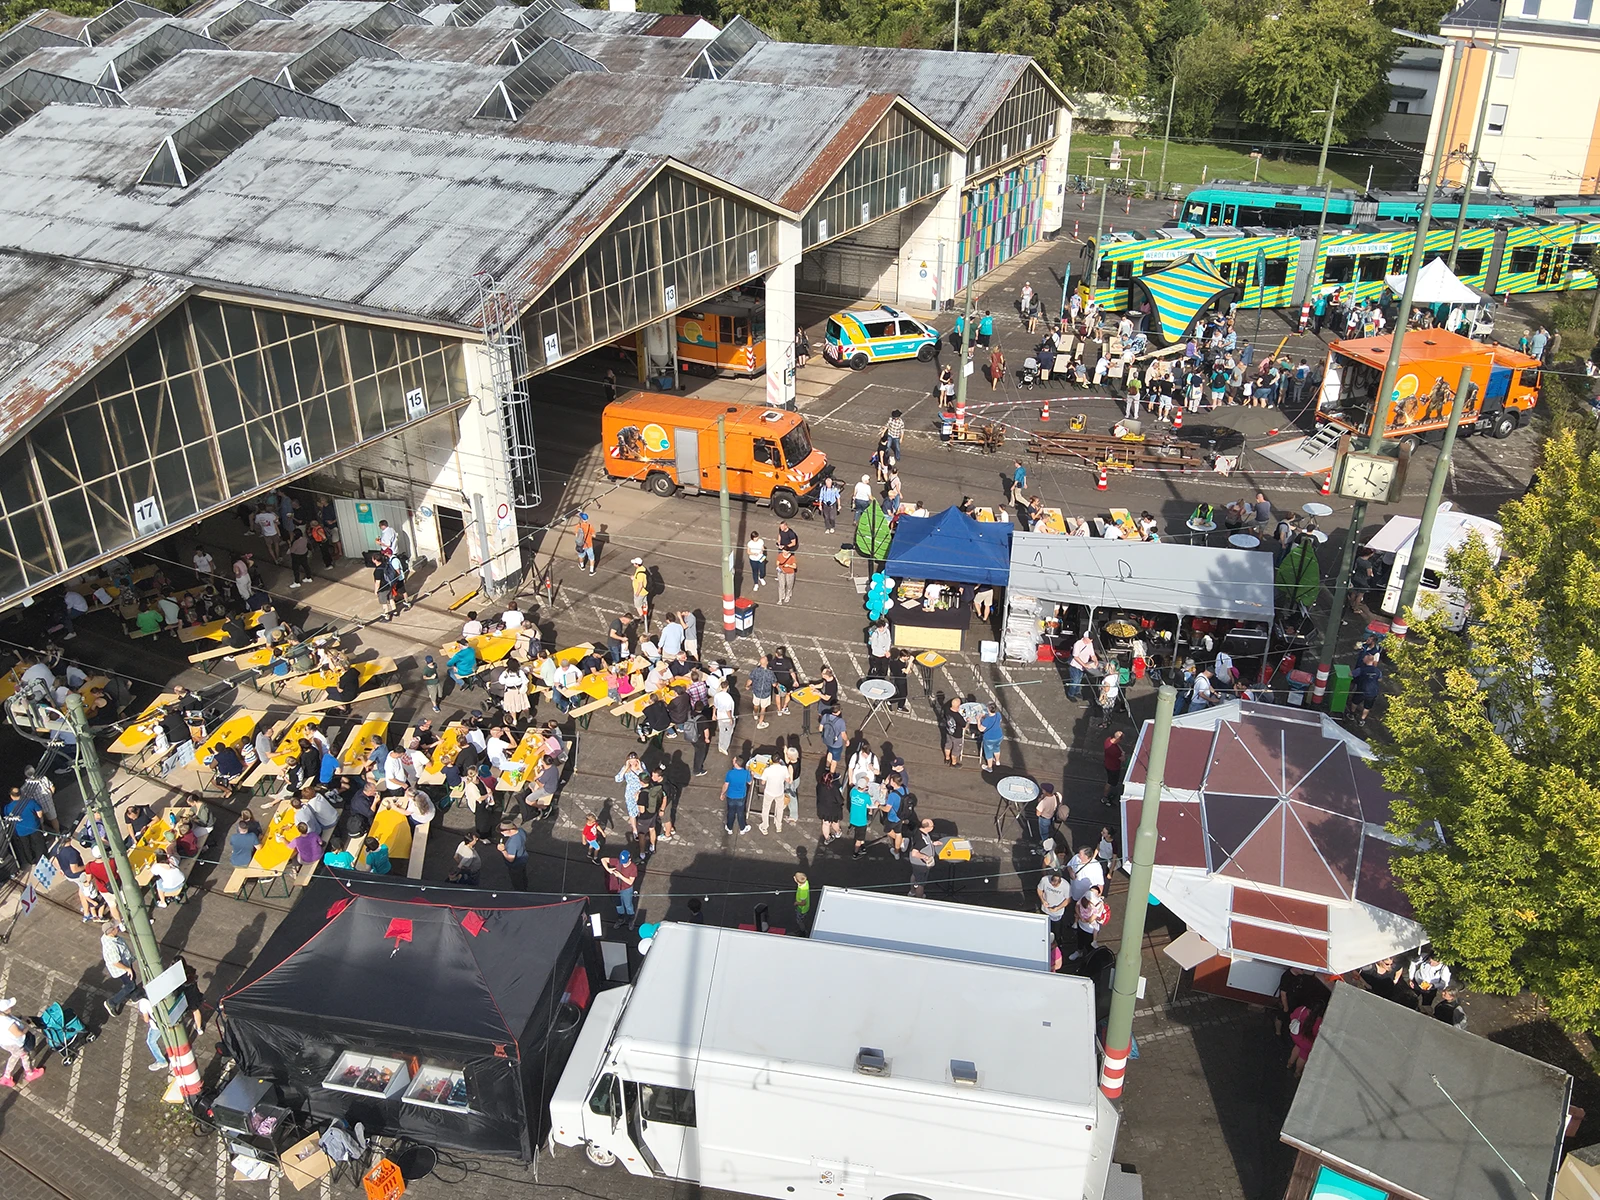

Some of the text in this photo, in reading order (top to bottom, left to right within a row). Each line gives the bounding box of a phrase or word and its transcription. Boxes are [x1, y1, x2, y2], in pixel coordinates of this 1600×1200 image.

[749, 253, 757, 265] 12
[666, 288, 675, 301] 13
[546, 338, 557, 351] 14
[408, 391, 422, 408] 15
[286, 441, 302, 459] 16
[136, 501, 154, 521] 17
